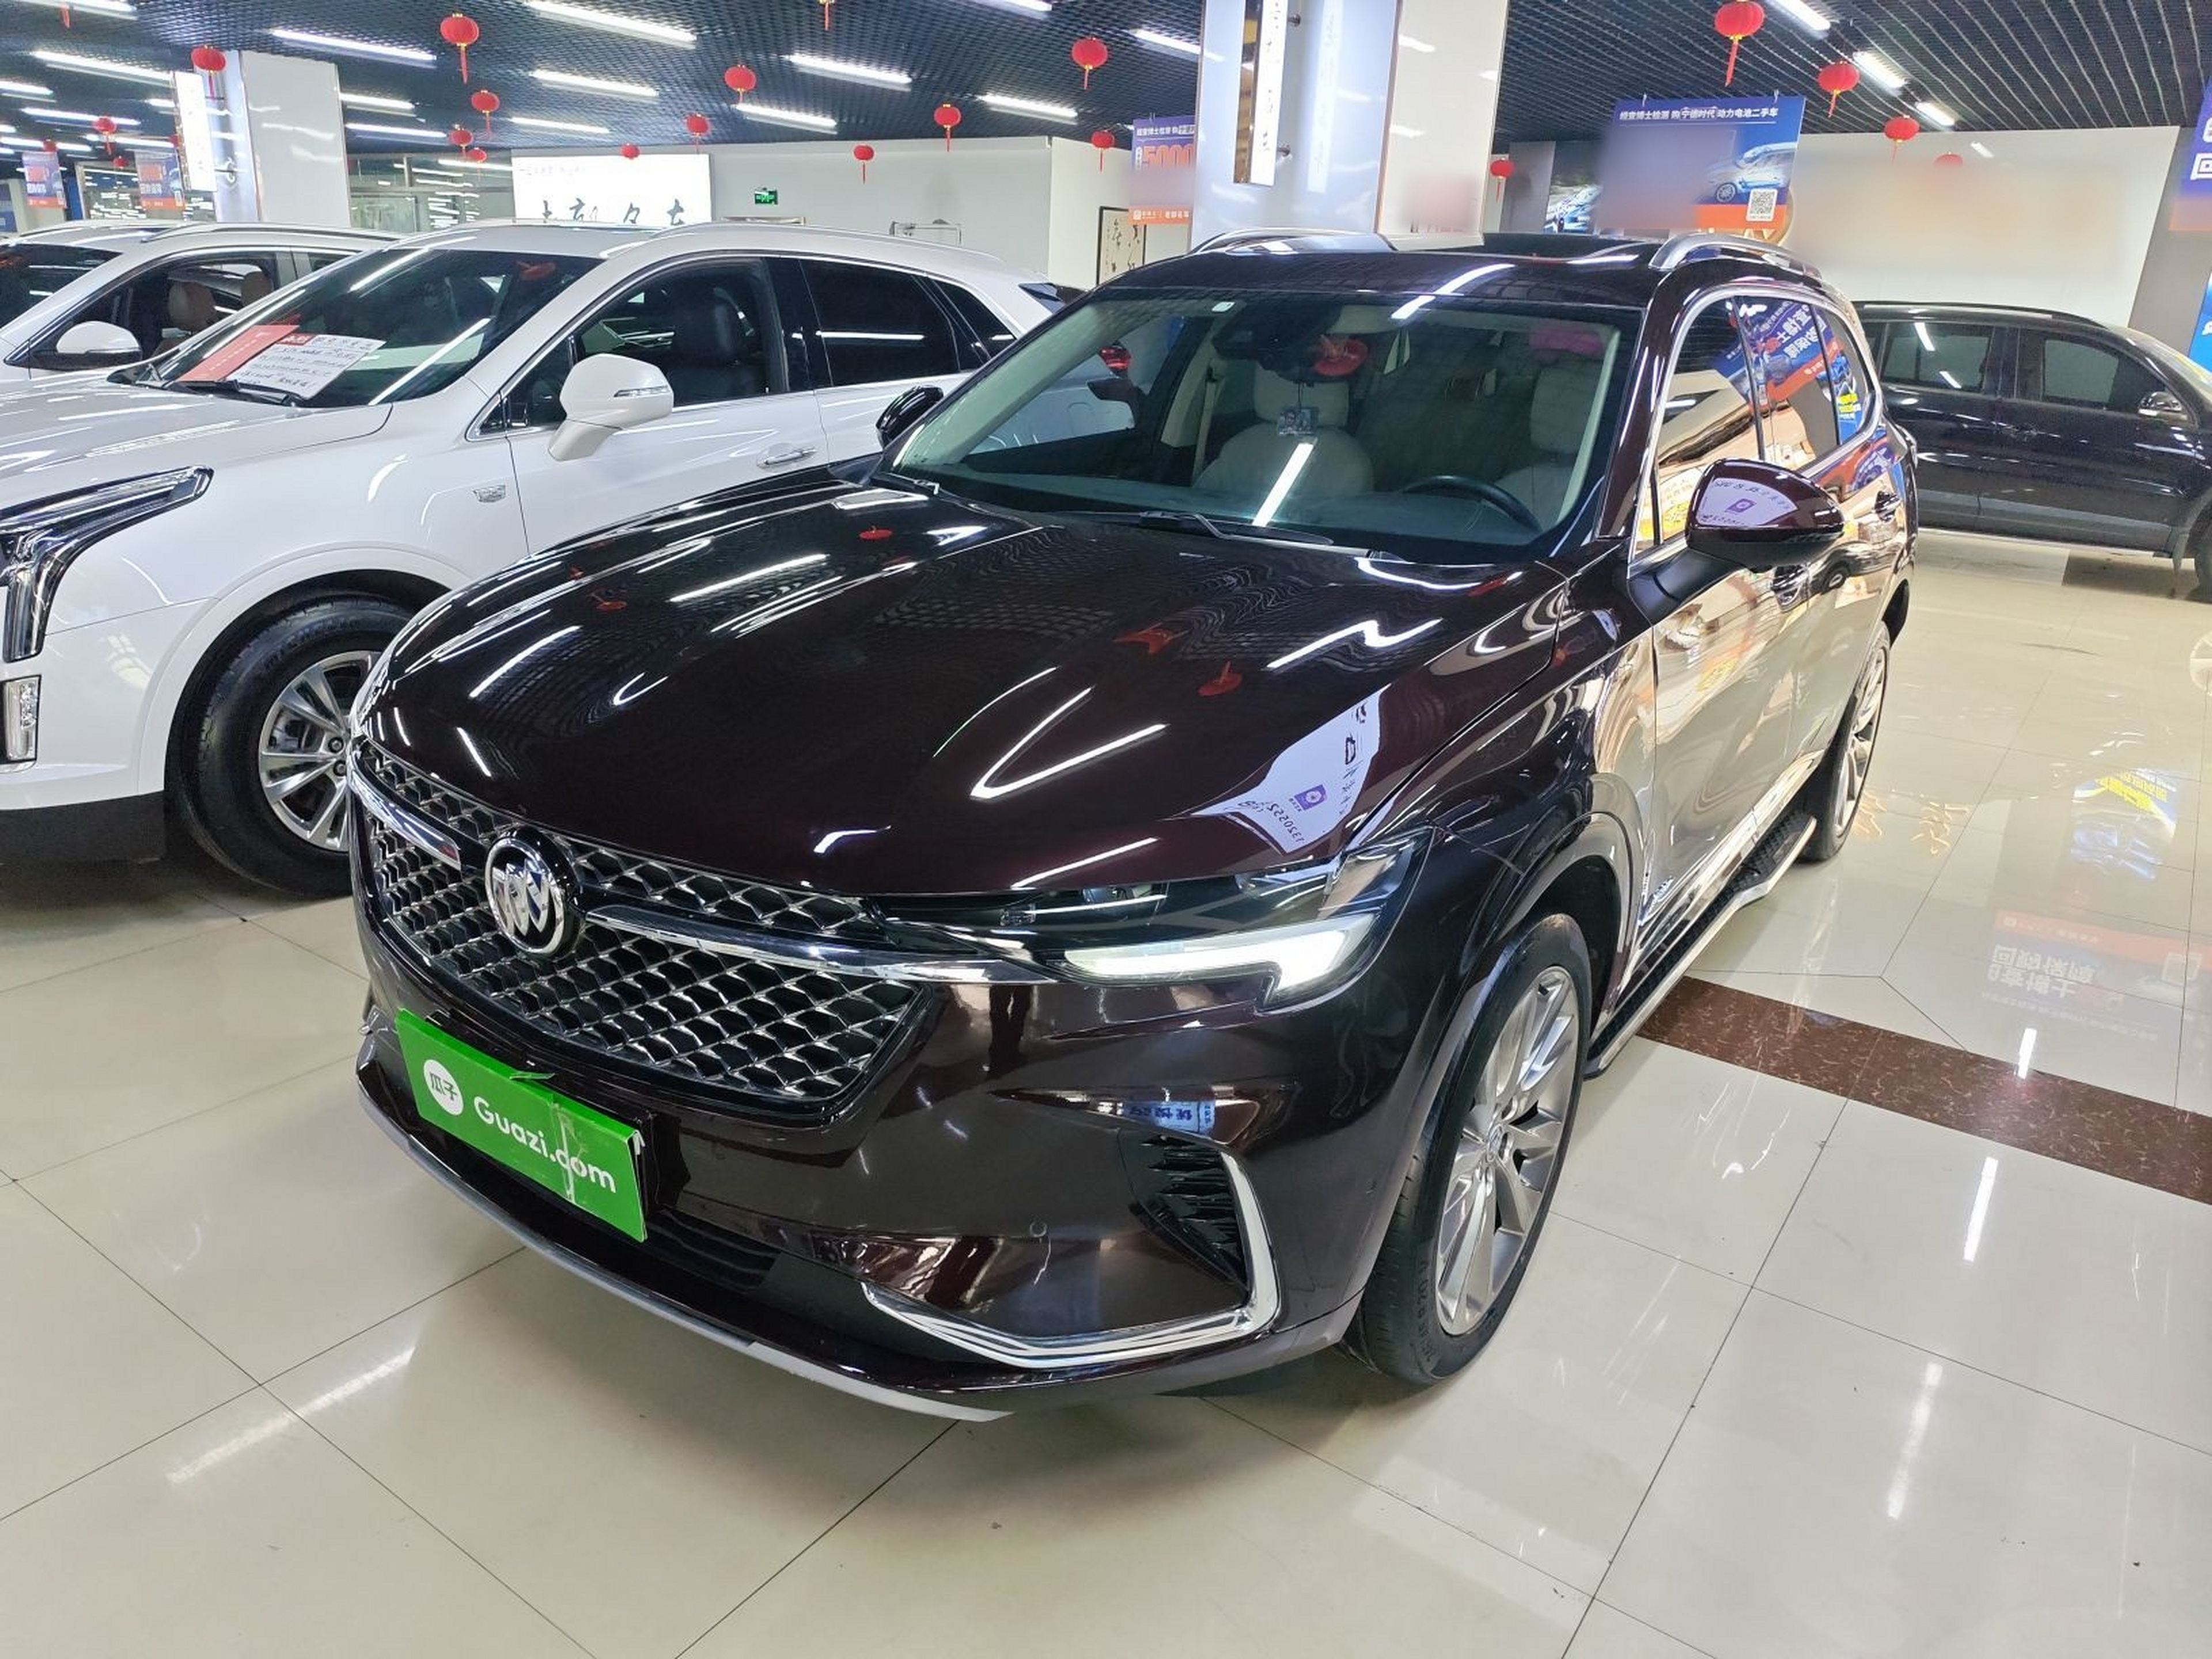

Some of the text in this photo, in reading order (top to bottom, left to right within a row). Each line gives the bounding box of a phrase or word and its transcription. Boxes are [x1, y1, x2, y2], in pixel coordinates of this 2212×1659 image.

[1717, 108, 1778, 119] 动力电池二手车
[429, 1072, 459, 1101] 瓜子
[474, 1096, 617, 1194] Guazi.com
